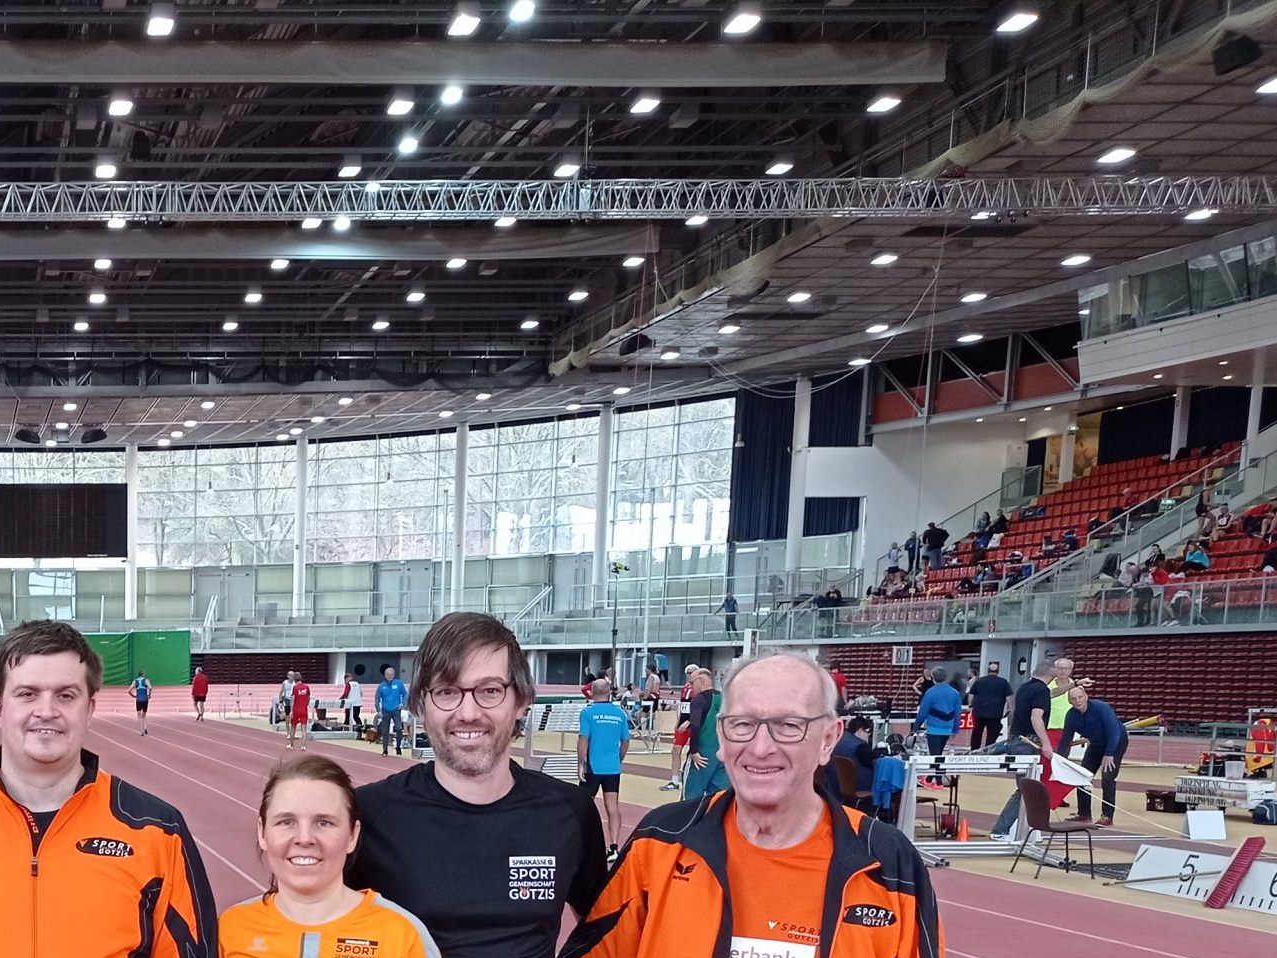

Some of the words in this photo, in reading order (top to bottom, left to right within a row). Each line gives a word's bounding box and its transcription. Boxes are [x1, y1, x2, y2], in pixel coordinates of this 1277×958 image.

[92, 839, 132, 851] SPORT
[509, 868, 556, 880] SPORT
[1179, 854, 1200, 882] 5
[509, 880, 555, 888] GEMEINSCHAFT
[855, 907, 895, 920] SPORT
[335, 944, 377, 956] SPORT
